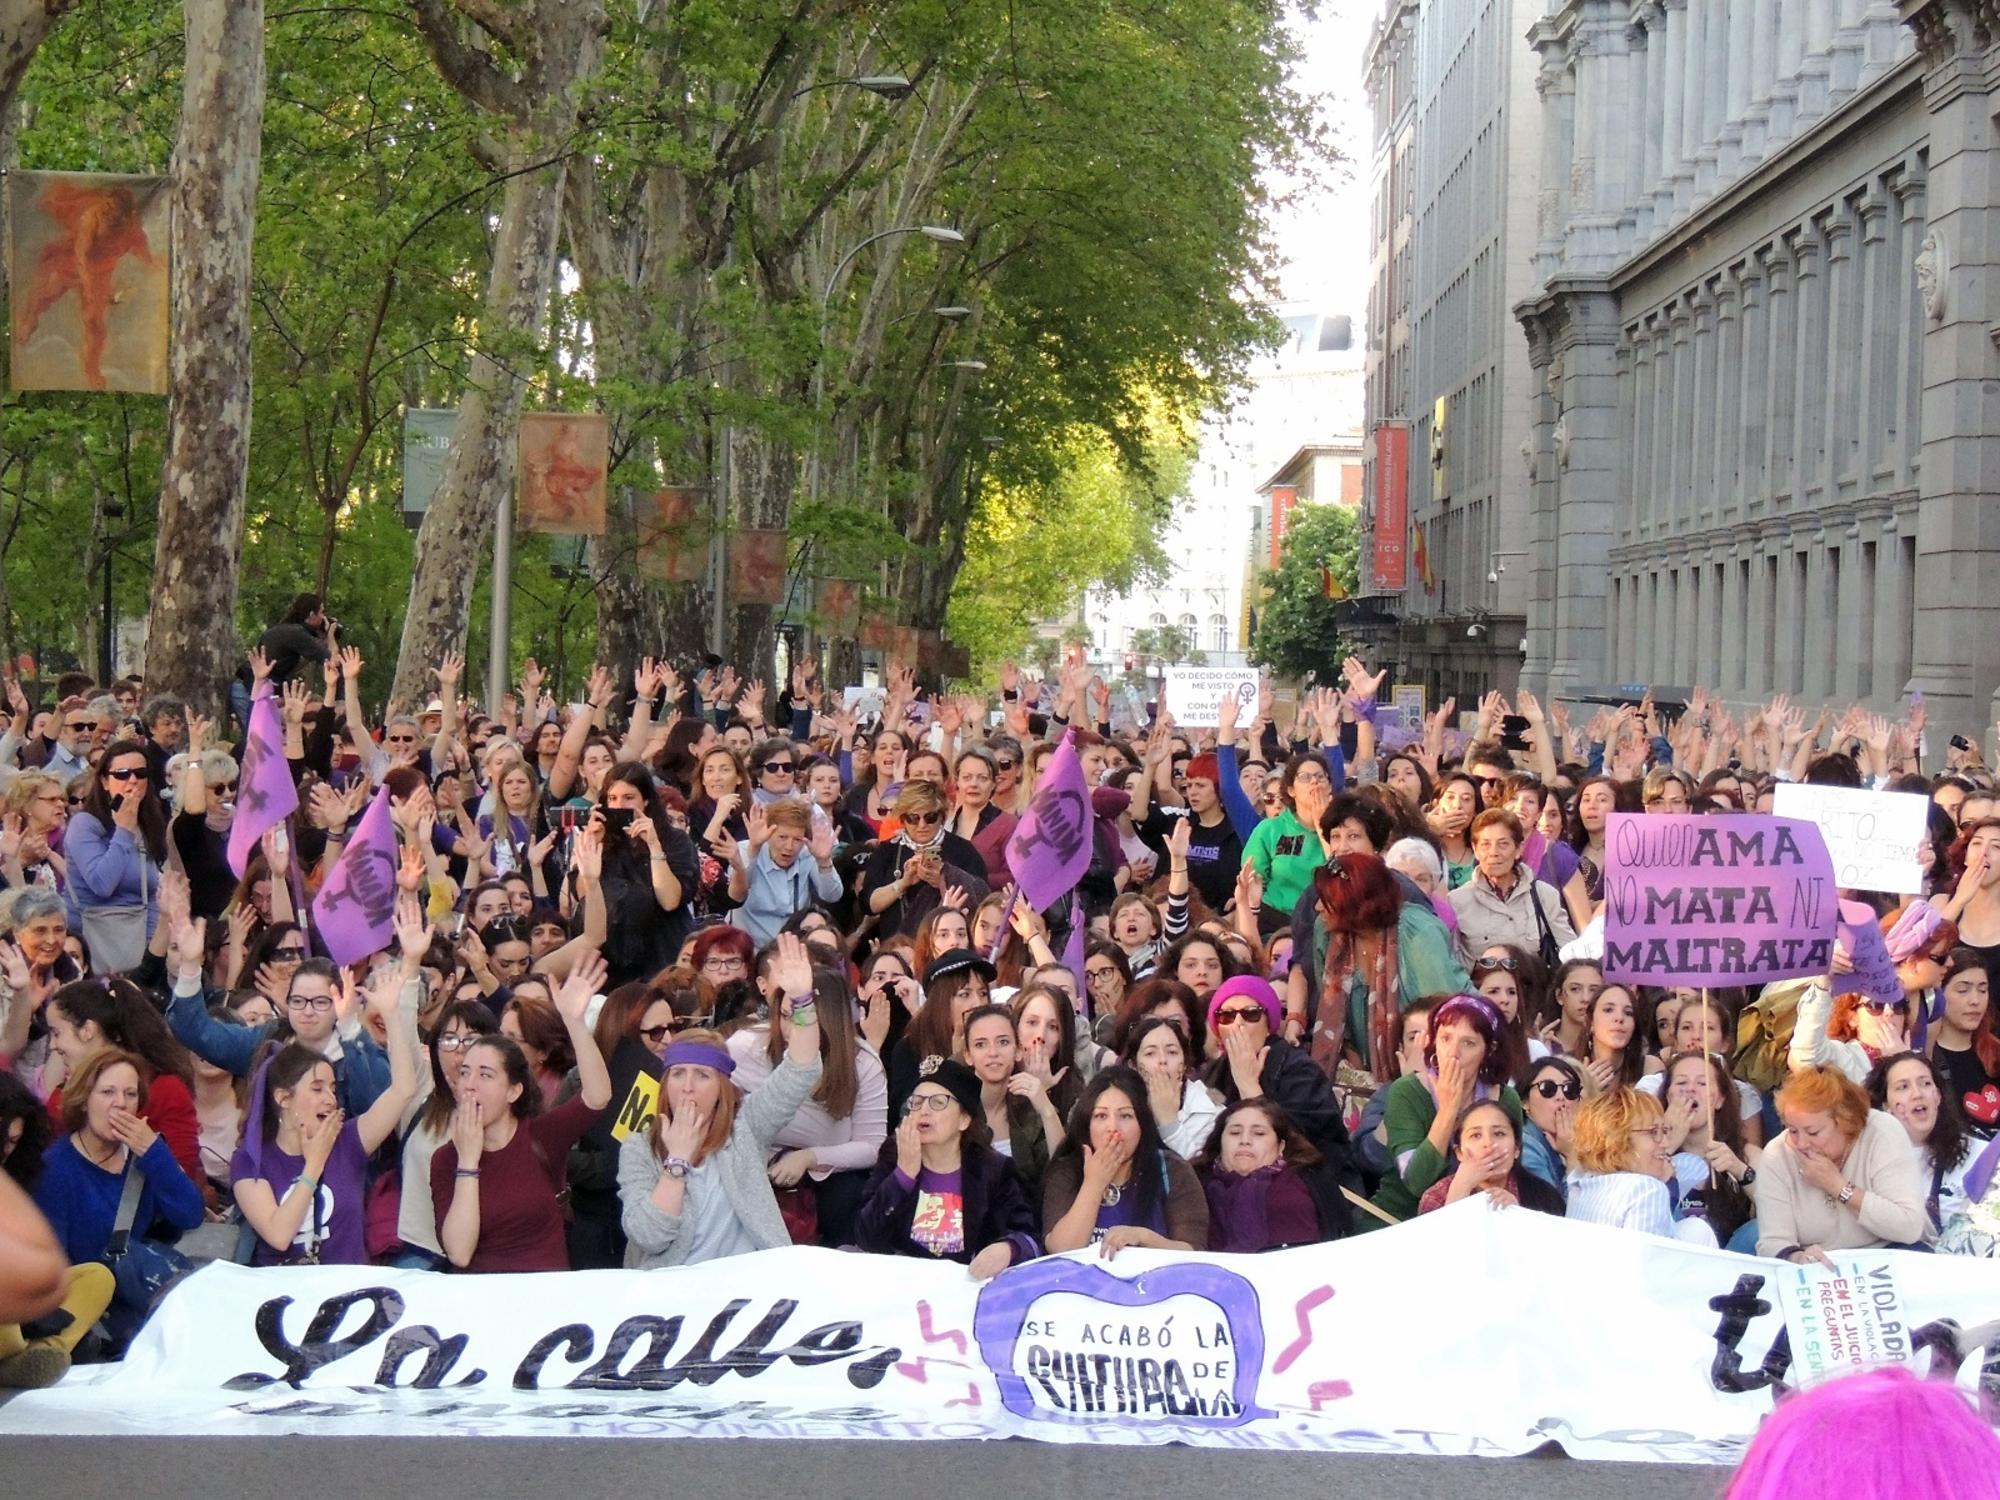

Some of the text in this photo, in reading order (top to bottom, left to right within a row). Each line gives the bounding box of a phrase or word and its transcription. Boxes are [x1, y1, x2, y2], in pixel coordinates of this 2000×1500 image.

[1691, 825, 1804, 867] AMA
[1606, 874, 1825, 930] NO MATA NI
[1605, 937, 1834, 974] MALTRATA
[1796, 1287, 1812, 1310] EN
[220, 1285, 488, 1394] La
[1026, 1315, 1229, 1348] SE ACABÓ LA
[1801, 1315, 1817, 1336] LA
[1817, 1281, 1844, 1361] PREGUNTAS
[1833, 1278, 1863, 1366] EN EL JUICIO
[1193, 1361, 1229, 1379] DE
